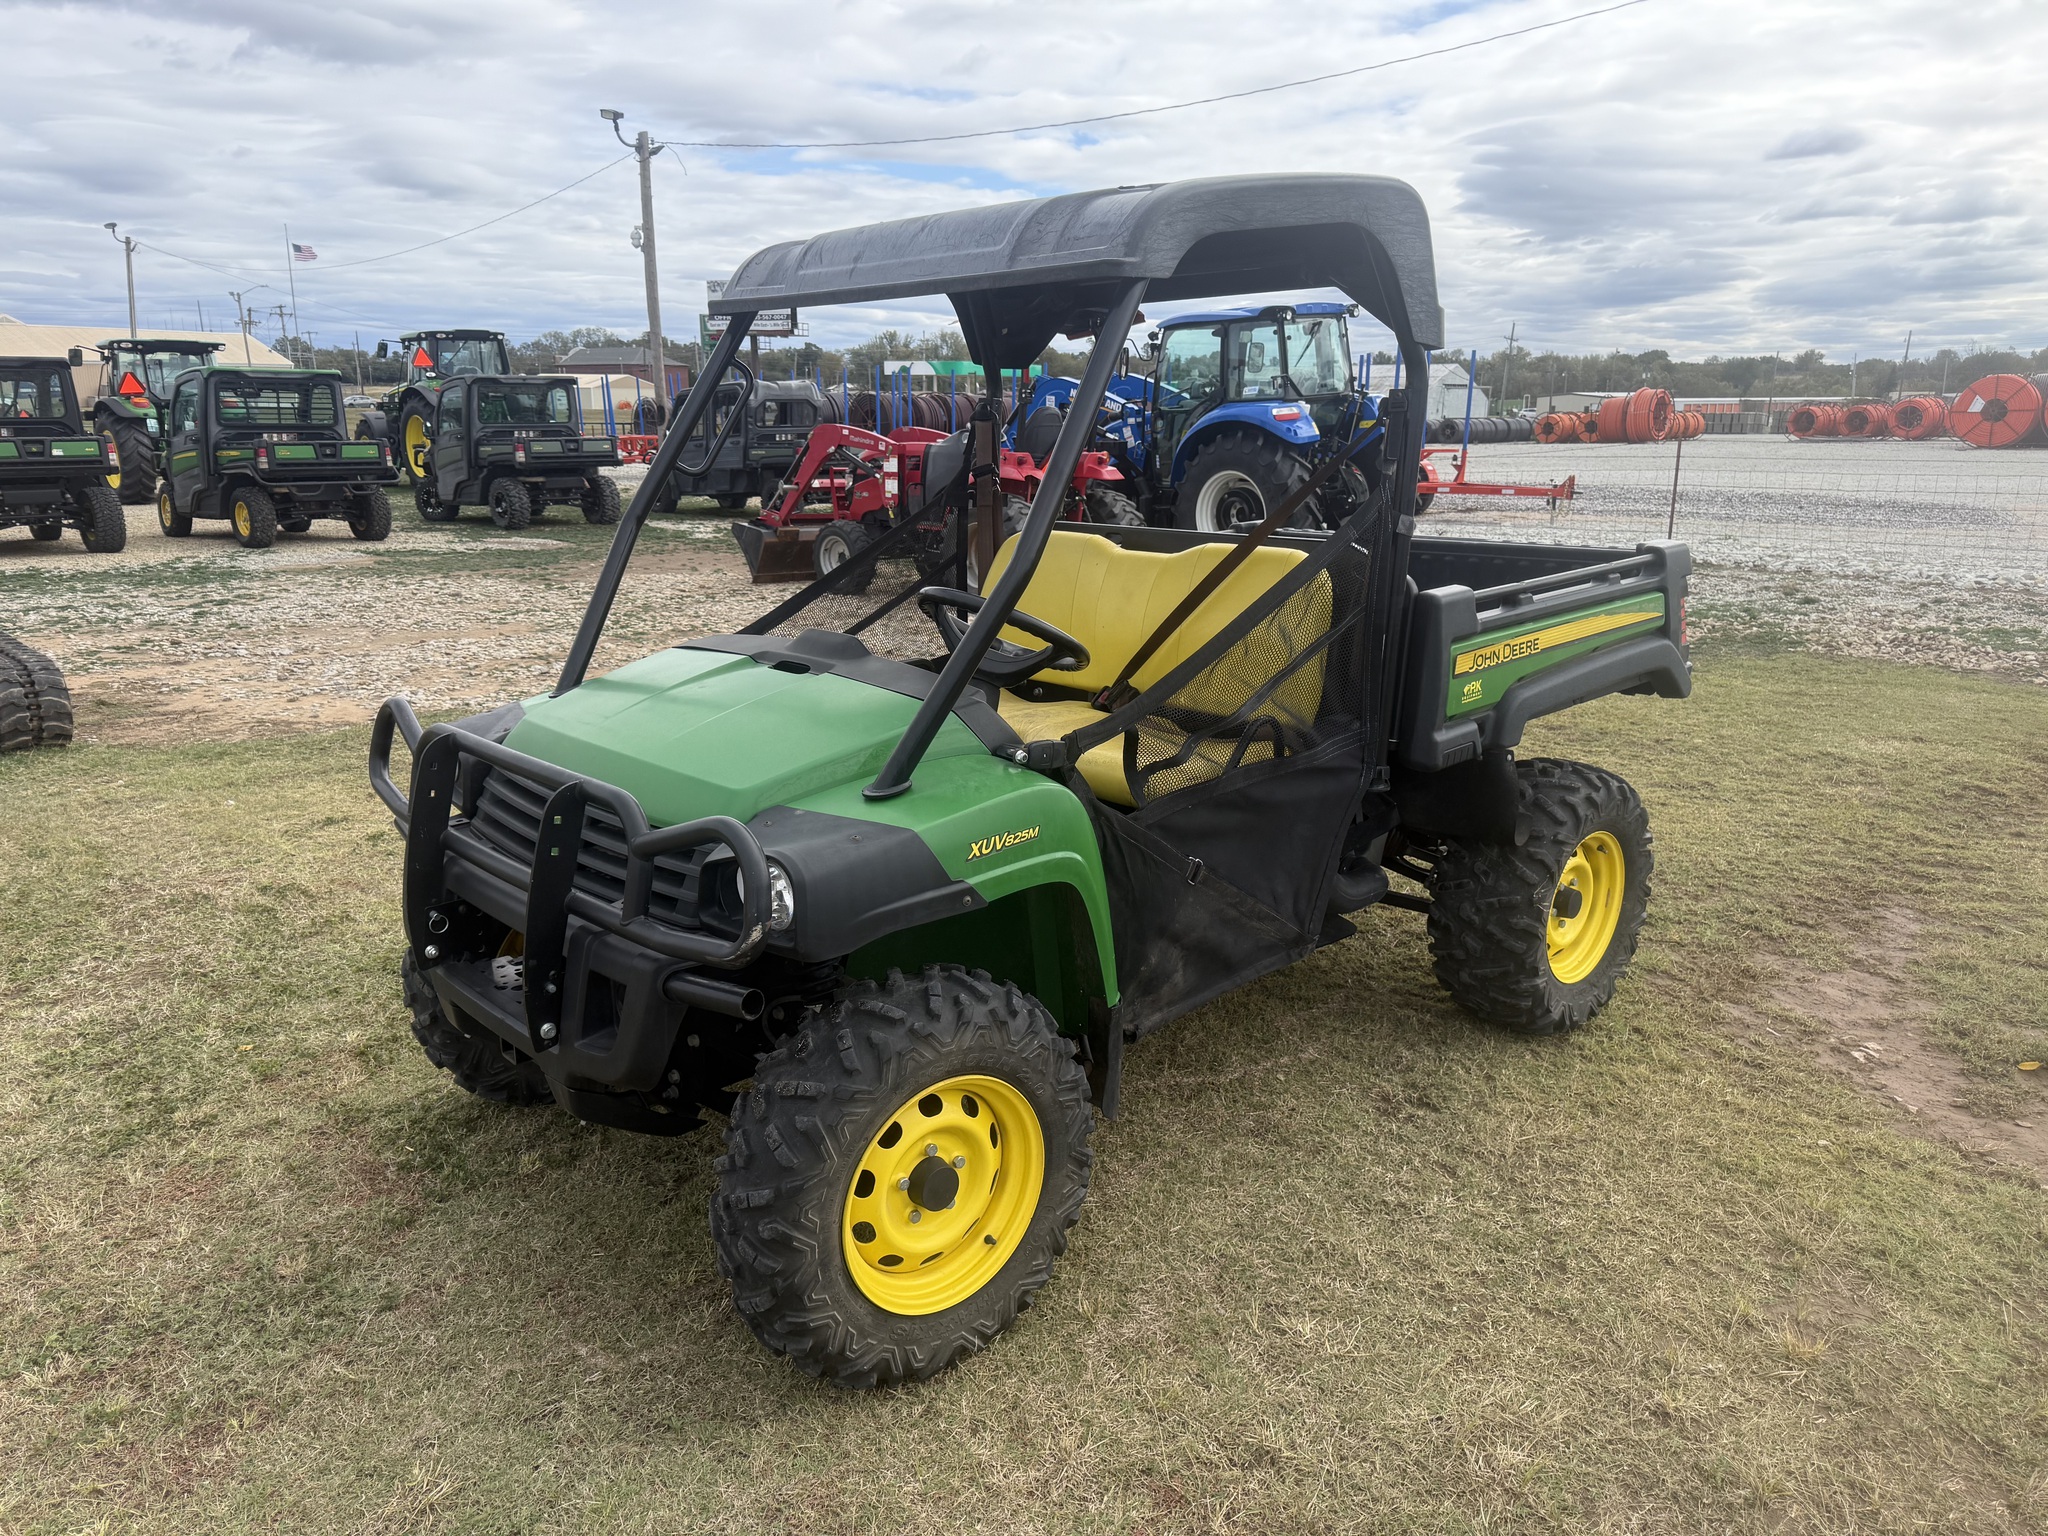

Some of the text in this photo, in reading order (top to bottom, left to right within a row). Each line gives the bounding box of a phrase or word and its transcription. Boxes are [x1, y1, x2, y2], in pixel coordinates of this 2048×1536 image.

[1468, 637, 1540, 671] JOHN DEERE
[967, 825, 1040, 861] XUV825M
